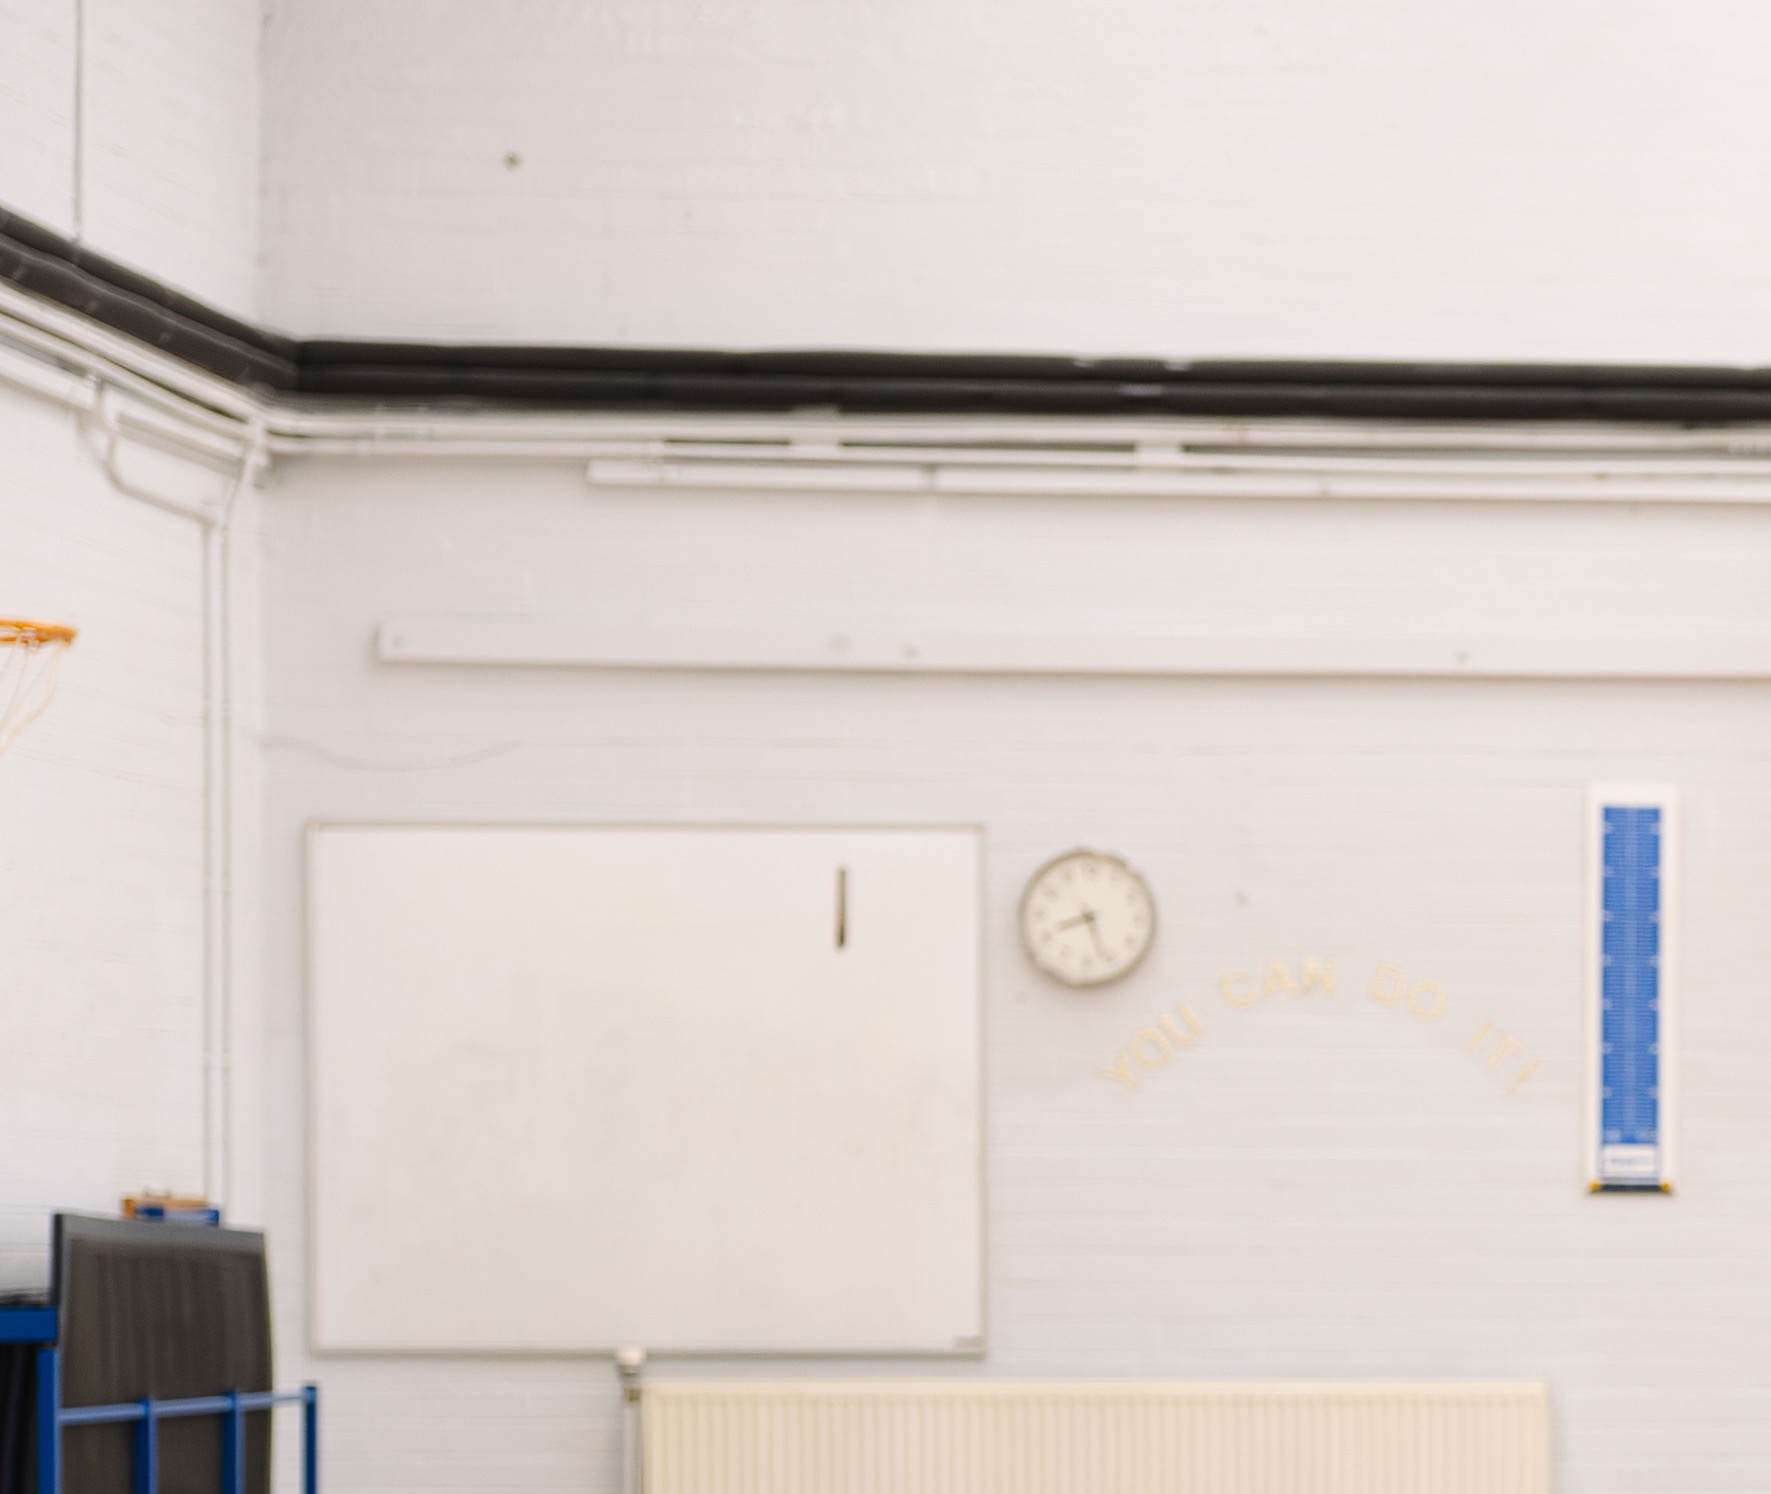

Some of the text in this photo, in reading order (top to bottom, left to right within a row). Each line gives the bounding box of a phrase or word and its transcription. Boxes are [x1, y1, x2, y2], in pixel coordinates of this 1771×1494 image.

[1101, 958, 1543, 1094] YOU CAN DO IT!
